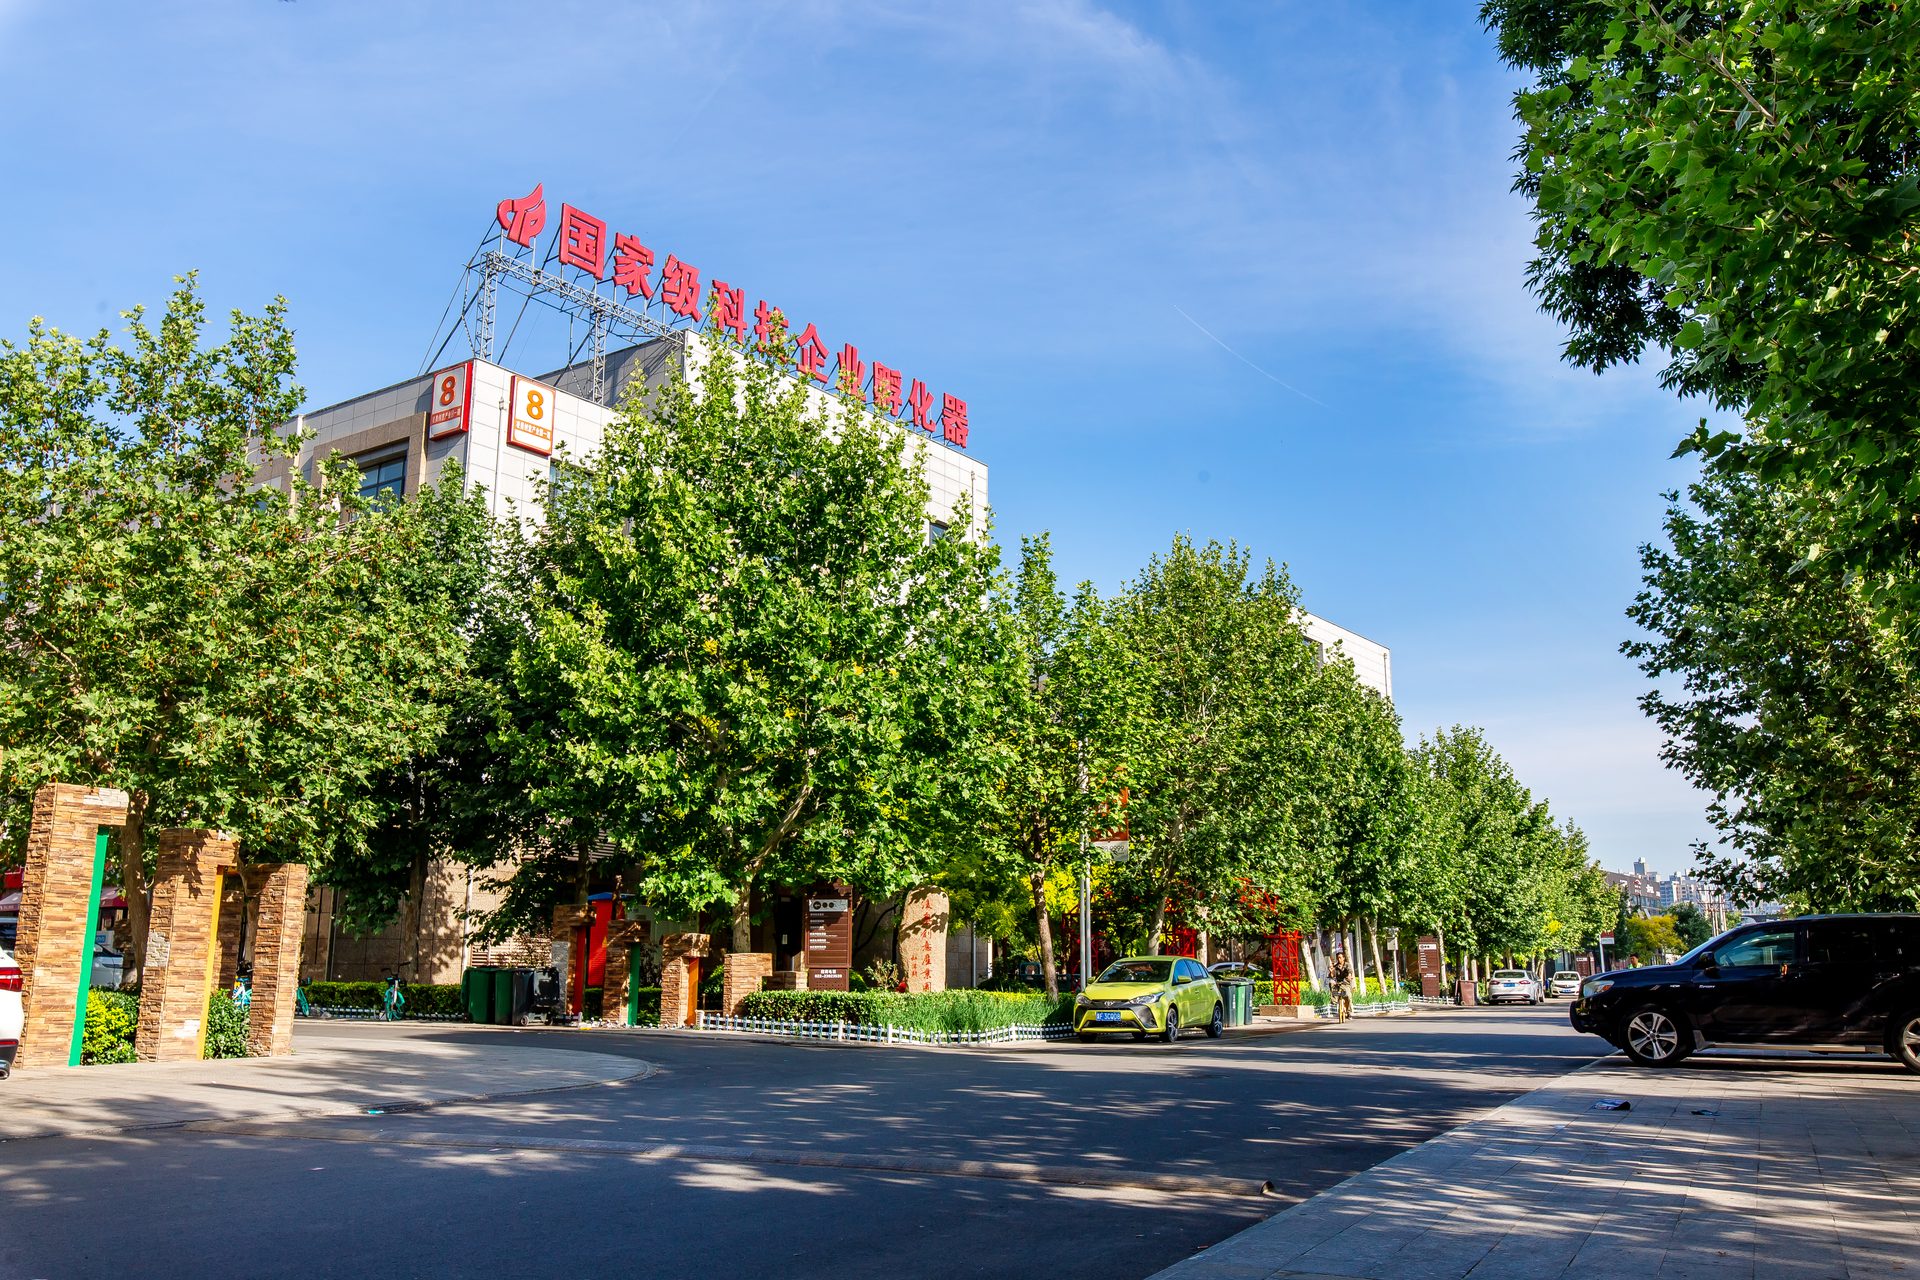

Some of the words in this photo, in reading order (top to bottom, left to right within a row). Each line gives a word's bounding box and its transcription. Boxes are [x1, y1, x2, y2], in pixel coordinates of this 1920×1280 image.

[559, 203, 969, 448] 国家级科技企业孵化器
[440, 375, 456, 405] 8
[526, 390, 544, 420] 8
